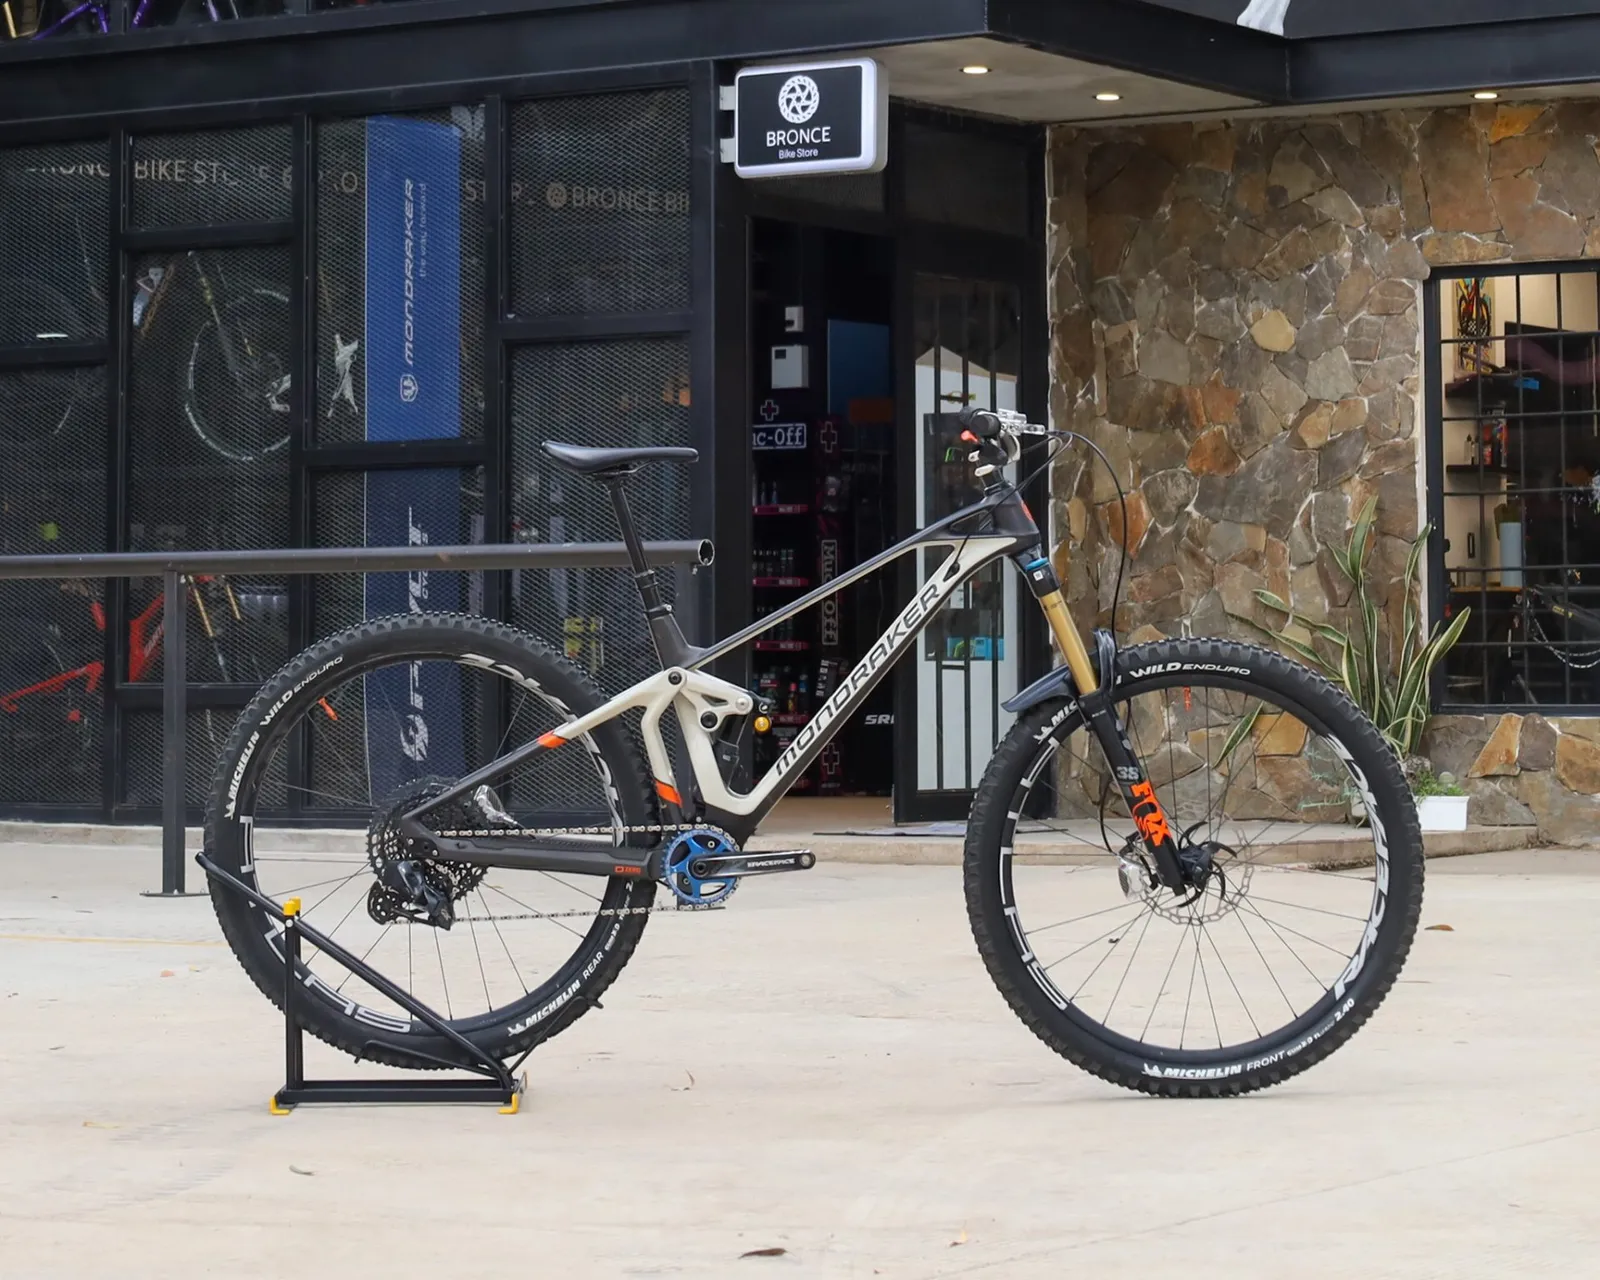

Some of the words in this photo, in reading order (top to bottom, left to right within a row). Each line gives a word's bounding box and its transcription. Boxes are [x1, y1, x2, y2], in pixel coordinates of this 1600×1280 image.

[766, 126, 831, 147] BRONCE
[778, 149, 796, 159] Bike
[796, 148, 819, 158] Store
[134, 160, 187, 182] BIKE
[572, 185, 659, 212] BRONCE
[418, 183, 427, 226] forward
[404, 178, 414, 367] MONDRAKER
[775, 583, 940, 776] MONDRAKER
[1129, 661, 1182, 679] WILD
[1182, 662, 1251, 676] ENDURO
[229, 730, 260, 797] MICHELIN
[260, 690, 293, 726] WILD
[293, 655, 344, 694] ENDURO
[1130, 779, 1174, 847] FOX
[525, 979, 582, 1027] MICHELIN
[582, 951, 604, 981] REAR
[1163, 1063, 1243, 1079] MICHELIN
[1246, 1049, 1286, 1072] FRONT
[1334, 997, 1356, 1023] 2.40
